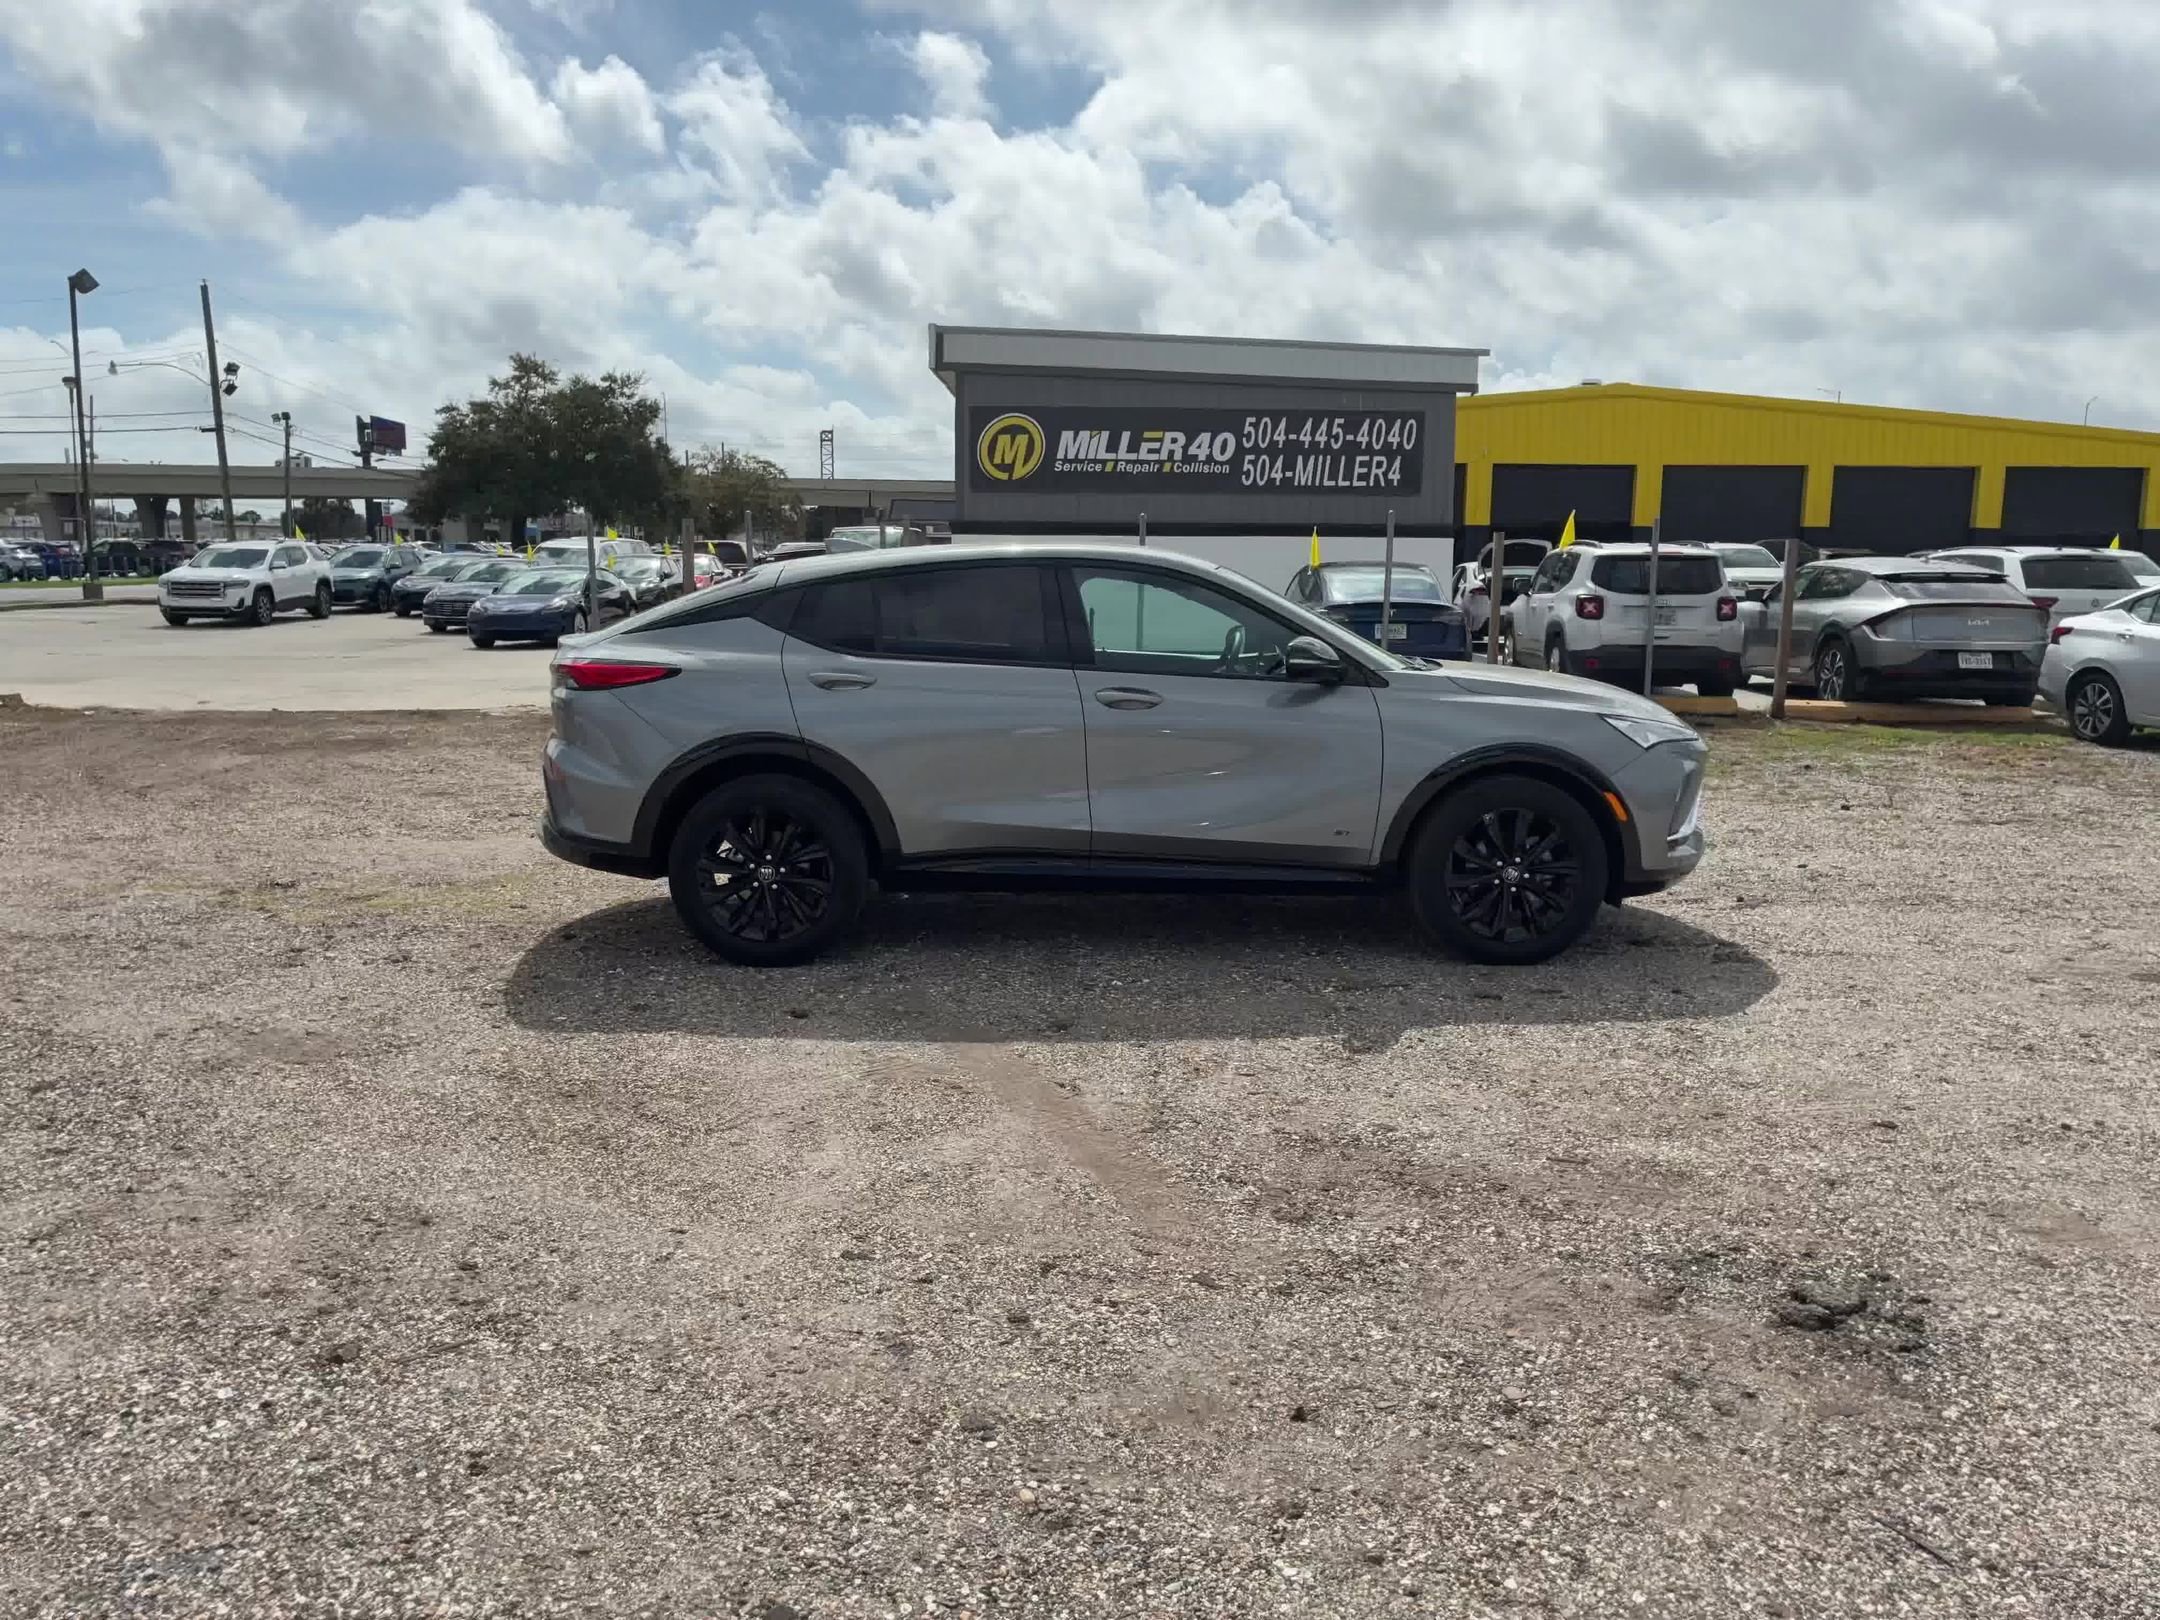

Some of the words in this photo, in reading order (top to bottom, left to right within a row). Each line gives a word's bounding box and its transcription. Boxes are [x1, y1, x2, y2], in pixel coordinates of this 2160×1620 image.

[1242, 416, 1417, 450] 504-445-4040
[1054, 460, 1102, 472] Service
[1116, 461, 1160, 475] Repair
[1173, 462, 1230, 474] Collision
[1241, 454, 1402, 487] 504-MILLER4
